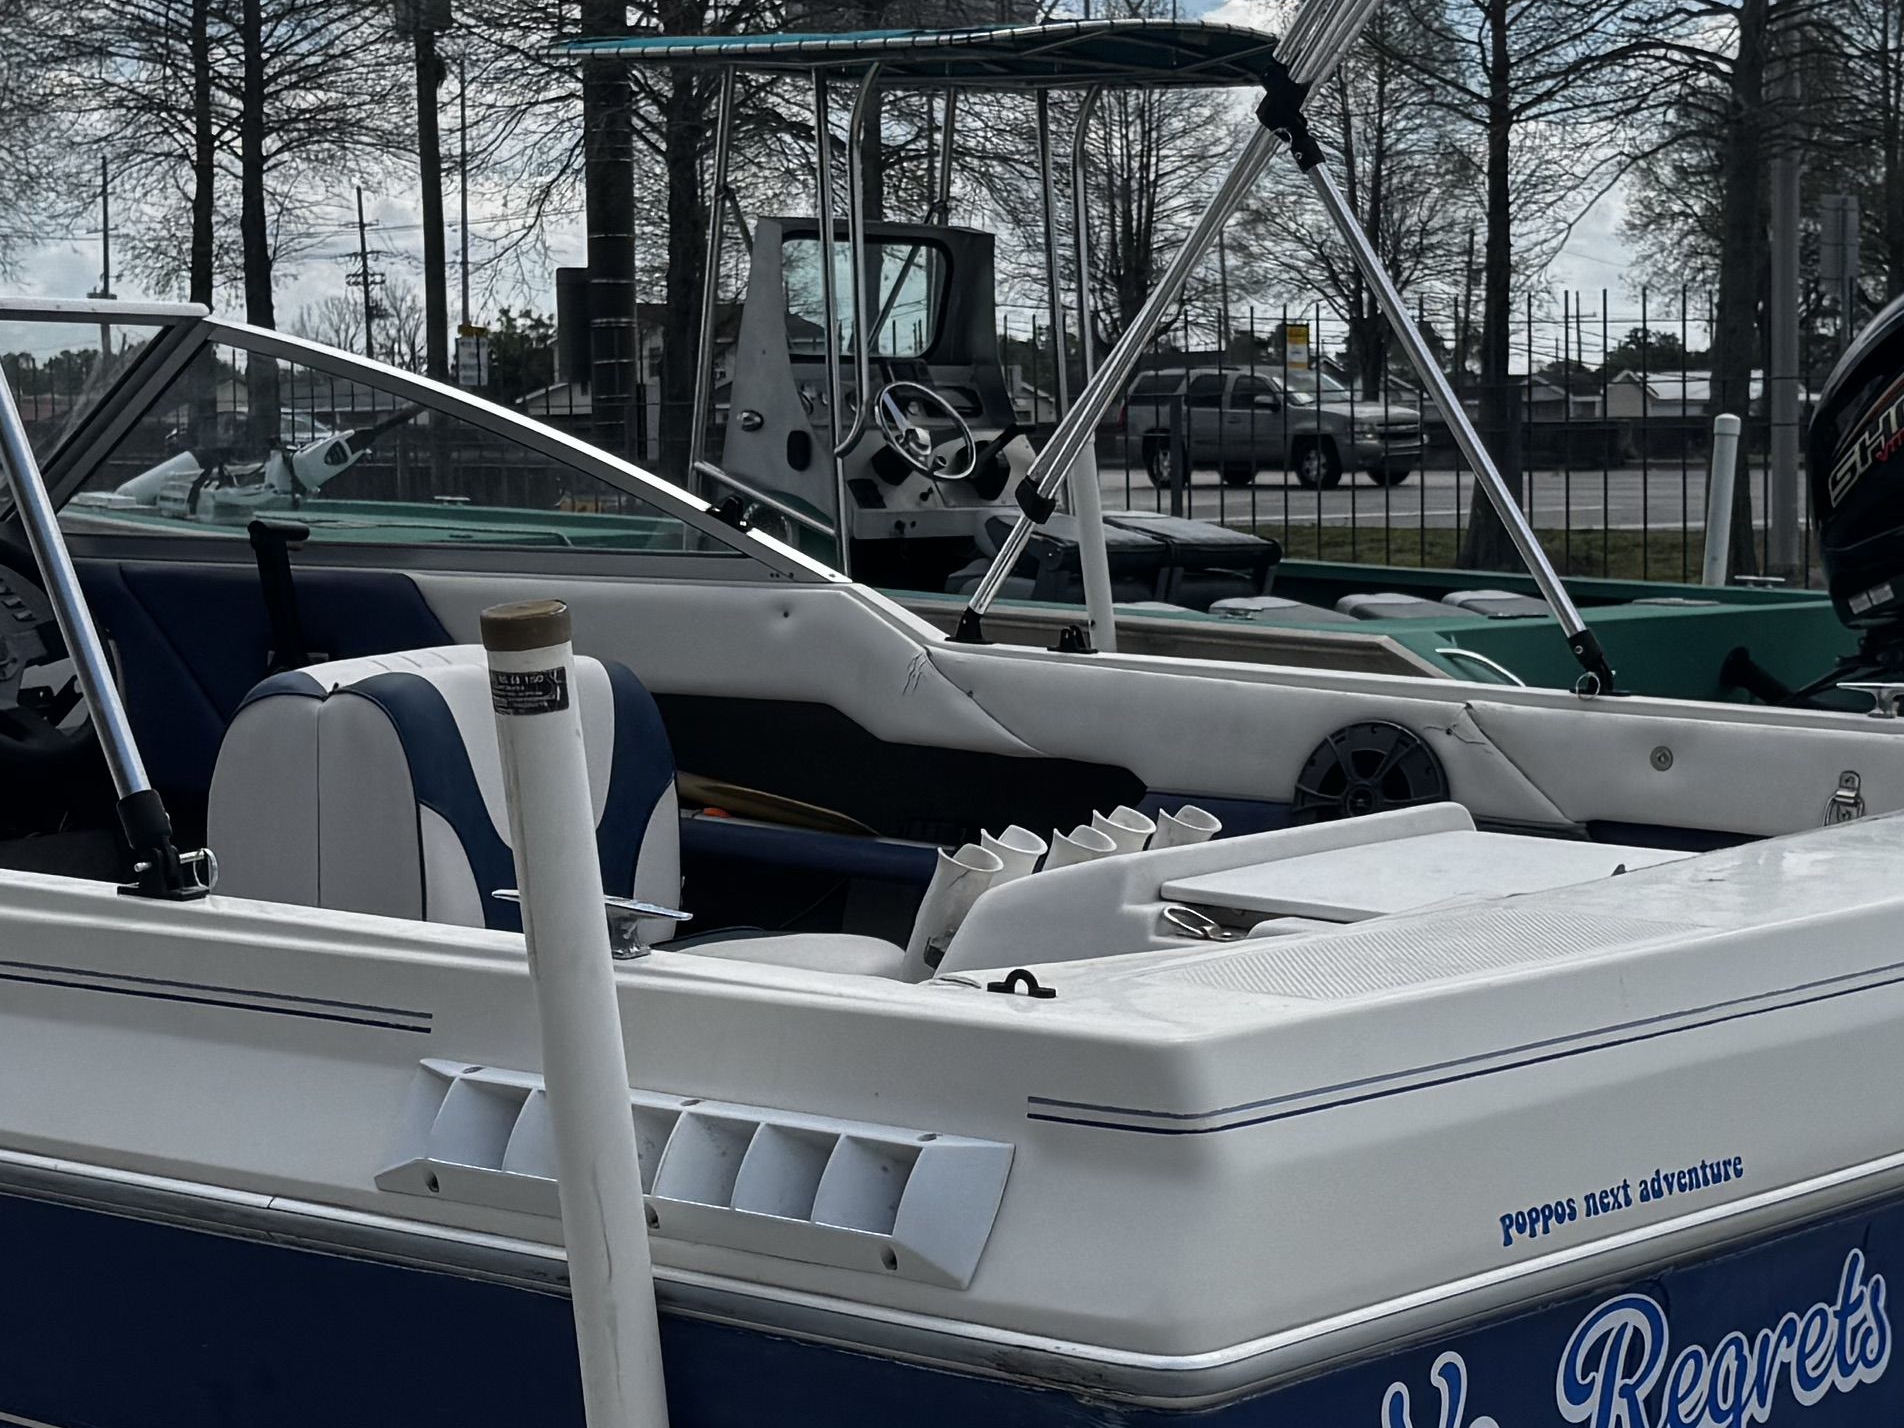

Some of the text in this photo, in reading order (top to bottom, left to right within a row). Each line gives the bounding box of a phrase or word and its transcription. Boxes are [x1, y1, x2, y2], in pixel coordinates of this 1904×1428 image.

[1499, 1155, 1745, 1247] poppos next adventure
